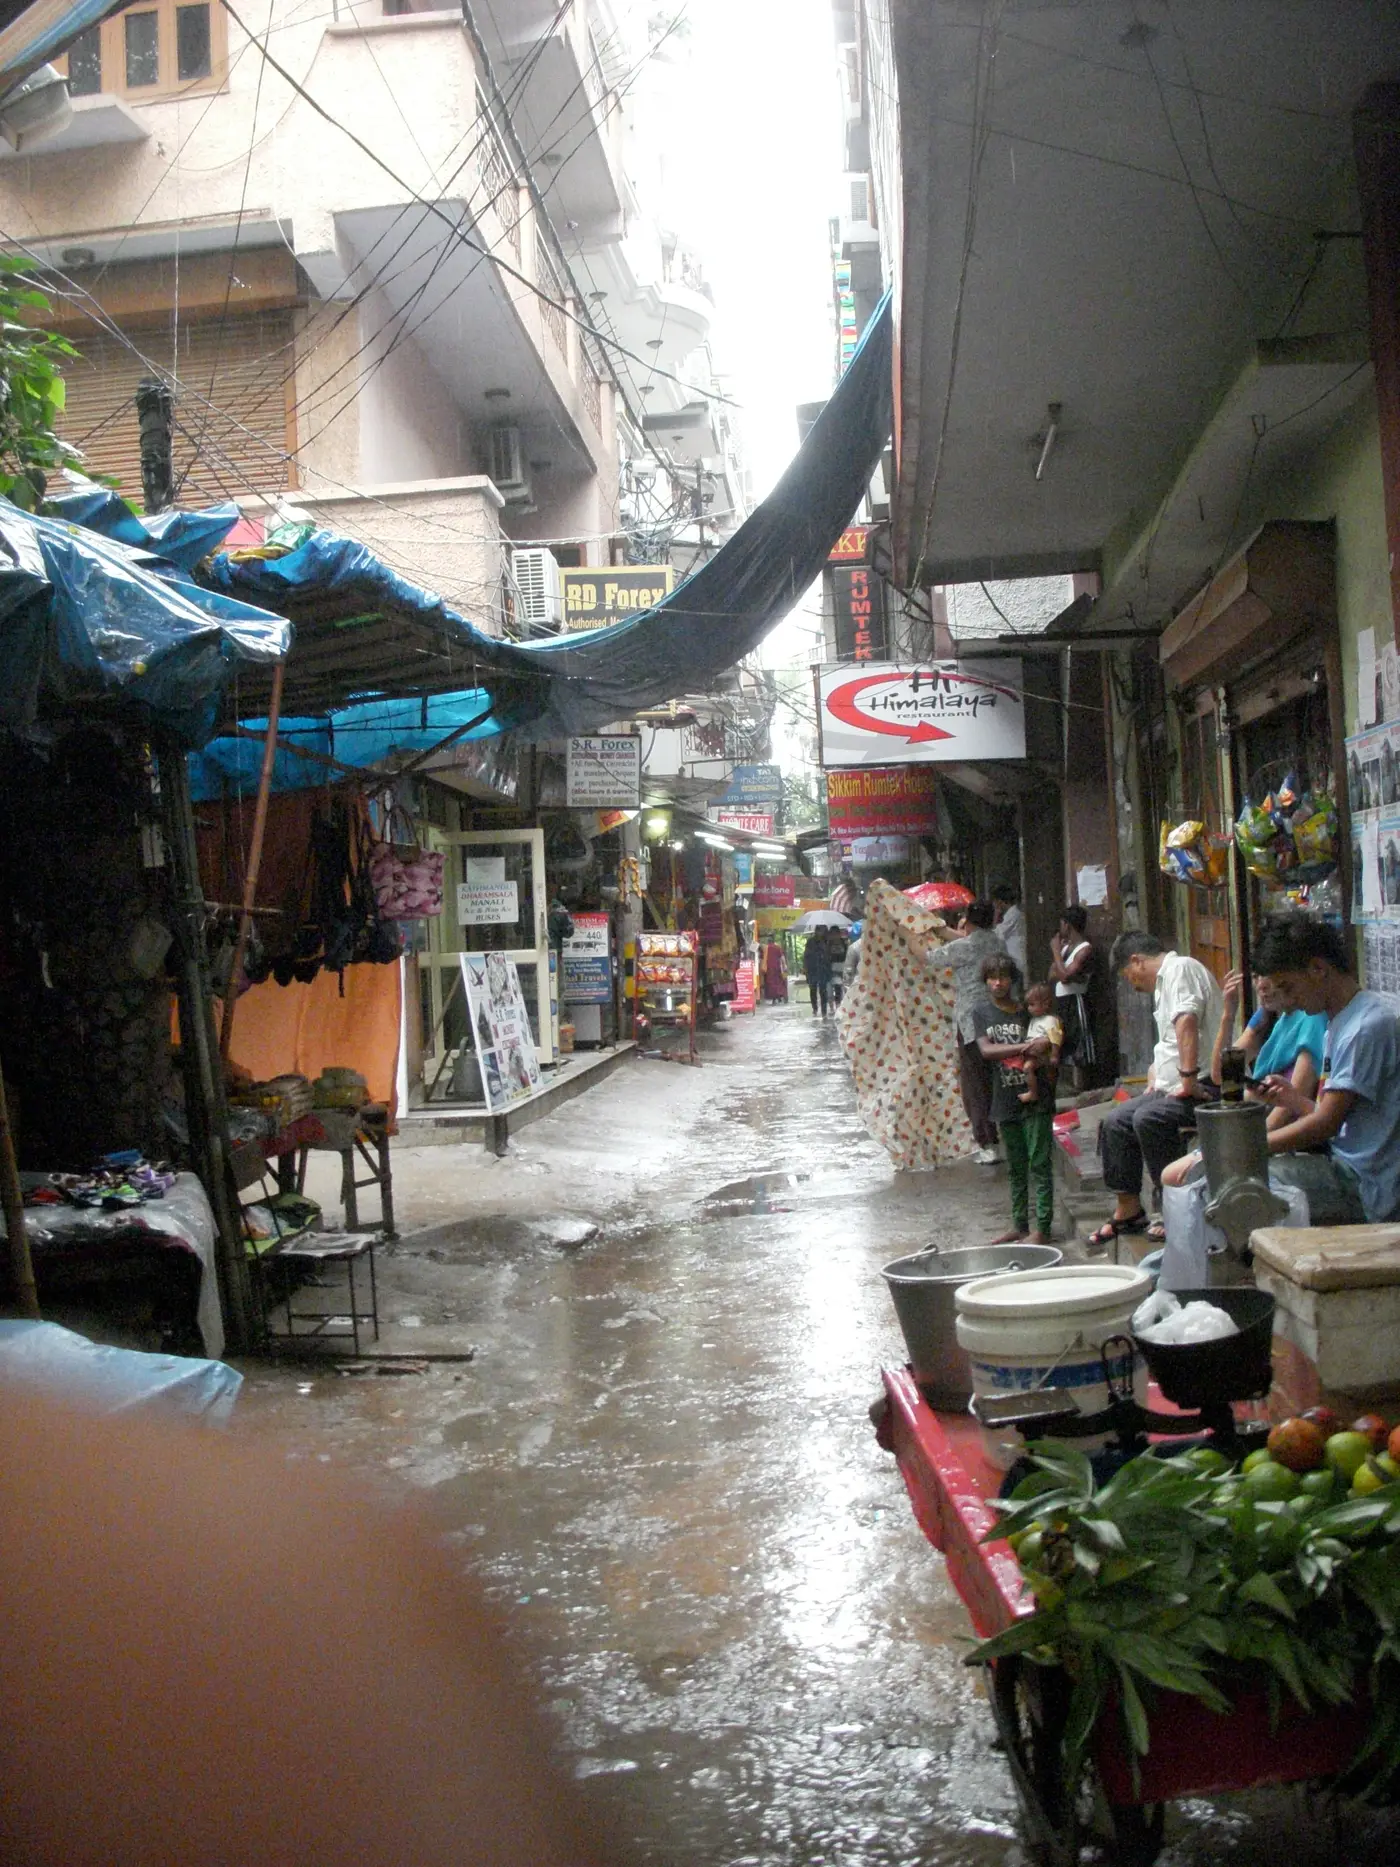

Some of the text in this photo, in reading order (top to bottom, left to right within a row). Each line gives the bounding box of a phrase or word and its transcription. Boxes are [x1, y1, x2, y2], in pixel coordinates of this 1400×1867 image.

[567, 583, 665, 611] RD Forex
[569, 617, 606, 629] Authorised
[851, 571, 872, 660] RUMTEK
[870, 692, 998, 718] Himalaya
[897, 711, 971, 719] restaurant
[572, 740, 635, 750] S.R. Forex
[828, 774, 861, 798] Sikkim
[750, 817, 770, 832] CARE
